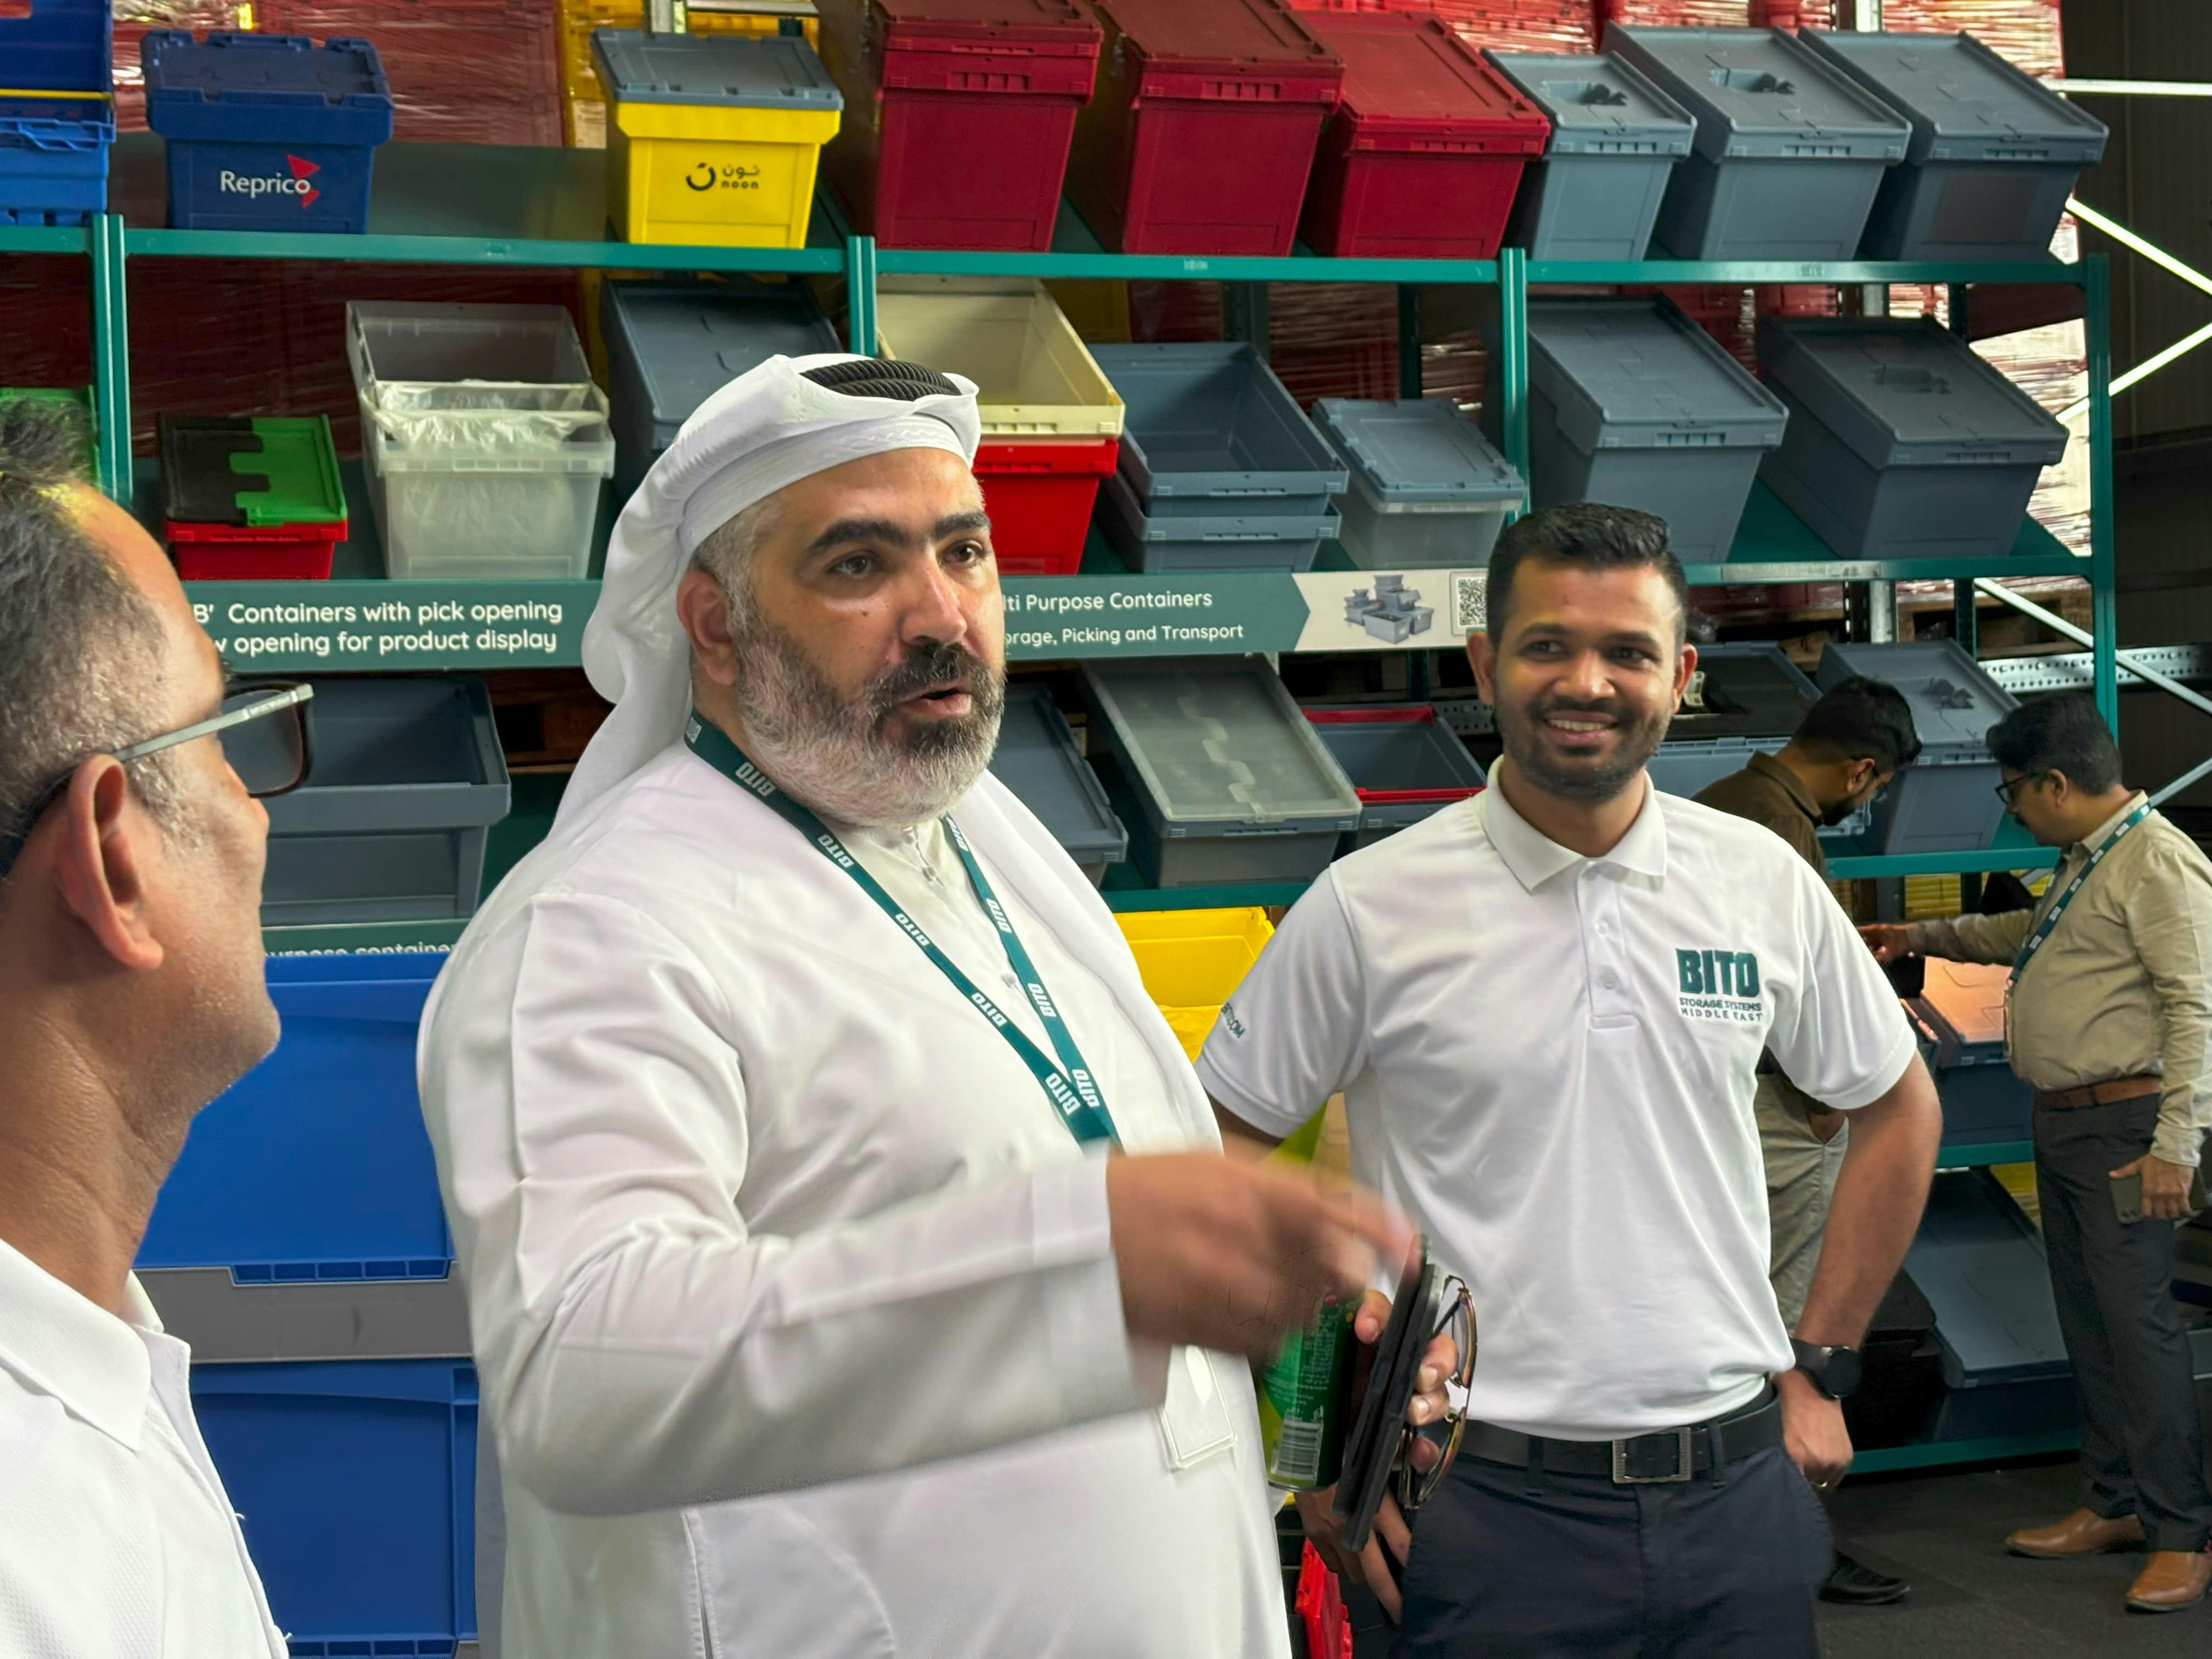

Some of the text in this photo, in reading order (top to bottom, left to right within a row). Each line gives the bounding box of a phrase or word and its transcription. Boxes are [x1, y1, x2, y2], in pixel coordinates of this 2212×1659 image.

[221, 170, 311, 199] Reprico
[721, 180, 759, 189] noon
[228, 602, 357, 624] Containers
[363, 601, 410, 622] with
[418, 600, 465, 626] pick
[471, 600, 562, 624] opening
[1026, 594, 1104, 614] Purpose
[1110, 591, 1212, 608] Containers
[234, 633, 330, 657] opening
[336, 631, 373, 652] for
[379, 630, 470, 656] product
[476, 629, 557, 653] display
[1062, 628, 1120, 645] Picking
[1125, 625, 1156, 641] and
[1161, 624, 1244, 640] Transport
[735, 762, 776, 797] BITO
[817, 834, 854, 868] BITO
[895, 913, 930, 946] BITO
[986, 898, 1013, 933] BITO
[1675, 948, 1760, 997] BITO
[972, 992, 1008, 1027] BITO
[1028, 983, 1057, 1017] BITO
[1679, 997, 1762, 1011] STORAGE SYSTEMS
[1681, 1007, 1763, 1022] MIDDLE EAST
[1045, 1072, 1081, 1116] BITO
[1071, 1069, 1101, 1108] BITO
